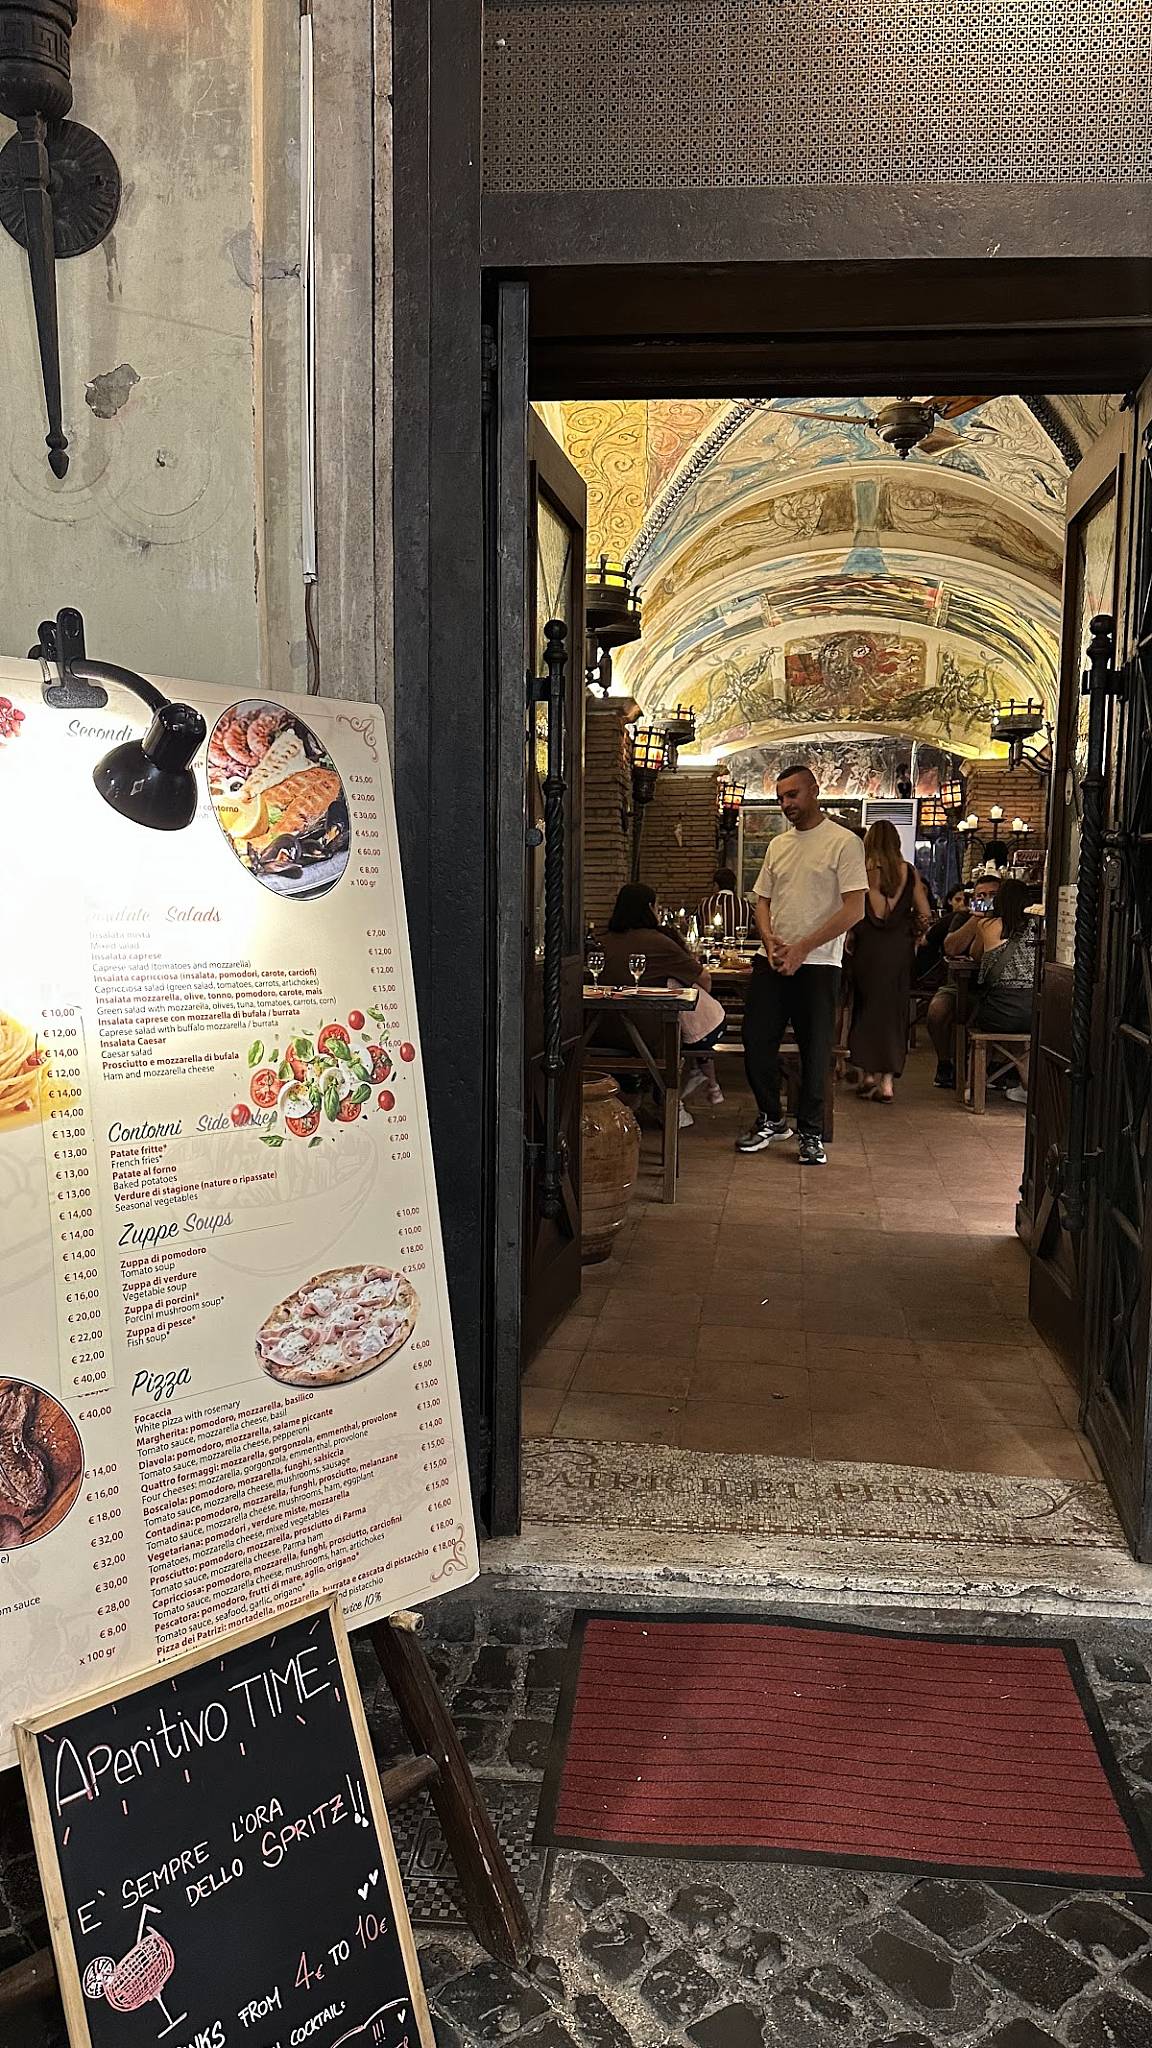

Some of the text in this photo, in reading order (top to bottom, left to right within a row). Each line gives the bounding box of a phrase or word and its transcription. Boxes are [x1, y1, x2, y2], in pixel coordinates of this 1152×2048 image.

[164, 905, 222, 923] Salads
[100, 1039, 135, 1047] Insalata
[102, 1060, 147, 1069] Prosciutto
[156, 1054, 202, 1064] mozzarella
[213, 1052, 239, 1060] bufala
[108, 1119, 183, 1143] Contorni
[196, 1113, 230, 1132] Side
[110, 1149, 139, 1158] Patate
[111, 1158, 140, 1168] French
[112, 1166, 176, 1180] Patate al forno
[113, 1176, 177, 1190] Baked potatoes
[114, 1191, 150, 1201] Verdure
[152, 1188, 160, 1196] di
[162, 1184, 199, 1194] stagione
[115, 1193, 197, 1212] Seasonal vegetables
[118, 1212, 234, 1249] Zuppe Soups
[120, 1248, 206, 1268] Zuppa di pomodoro
[122, 1263, 175, 1278] Tomato soup
[122, 1272, 197, 1291] Zuppa di verdure
[123, 1284, 186, 1300] Vegetable soup
[124, 1304, 153, 1314] Zuppa
[155, 1299, 163, 1308] di
[125, 1311, 154, 1323] Porcini
[155, 1303, 200, 1317] mushroom
[126, 1326, 155, 1337] Zuppa
[157, 1322, 165, 1330] di
[127, 1337, 144, 1347] Fish
[131, 1367, 192, 1401] Pizza
[134, 1408, 171, 1423] Focaccia
[135, 1401, 240, 1434] White pizza with rosemary
[136, 1427, 188, 1446] Margherita:
[285, 1393, 313, 1405] basilico
[140, 1478, 175, 1492] Quattro
[177, 1463, 219, 1482] formaggi:
[361, 1411, 397, 1428] provolone
[150, 1565, 197, 1585] Prosciutto:
[294, 1519, 332, 1538] prosciutto
[334, 1514, 341, 1522] di
[342, 1507, 366, 1519] Parma
[348, 1577, 383, 1596] pistacchio
[13, 1596, 41, 1612] sauce
[156, 1642, 179, 1655] Pizza
[181, 1634, 195, 1646] dei
[197, 1624, 226, 1640] Patrizi:
[358, 1566, 384, 1580] cascata
[385, 1561, 392, 1569] di
[394, 1549, 428, 1568] pistacchio
[87, 1649, 105, 1663] 100
[106, 1645, 116, 1658] gr
[228, 1646, 331, 1728] TIME
[122, 1840, 210, 1910] SEMPRE
[231, 1797, 284, 1843] L'ORA
[185, 1858, 244, 1907] DELLO
[237, 1986, 283, 2029] FROM
[327, 1940, 350, 1966] TO
[355, 1913, 389, 1949] 10€
